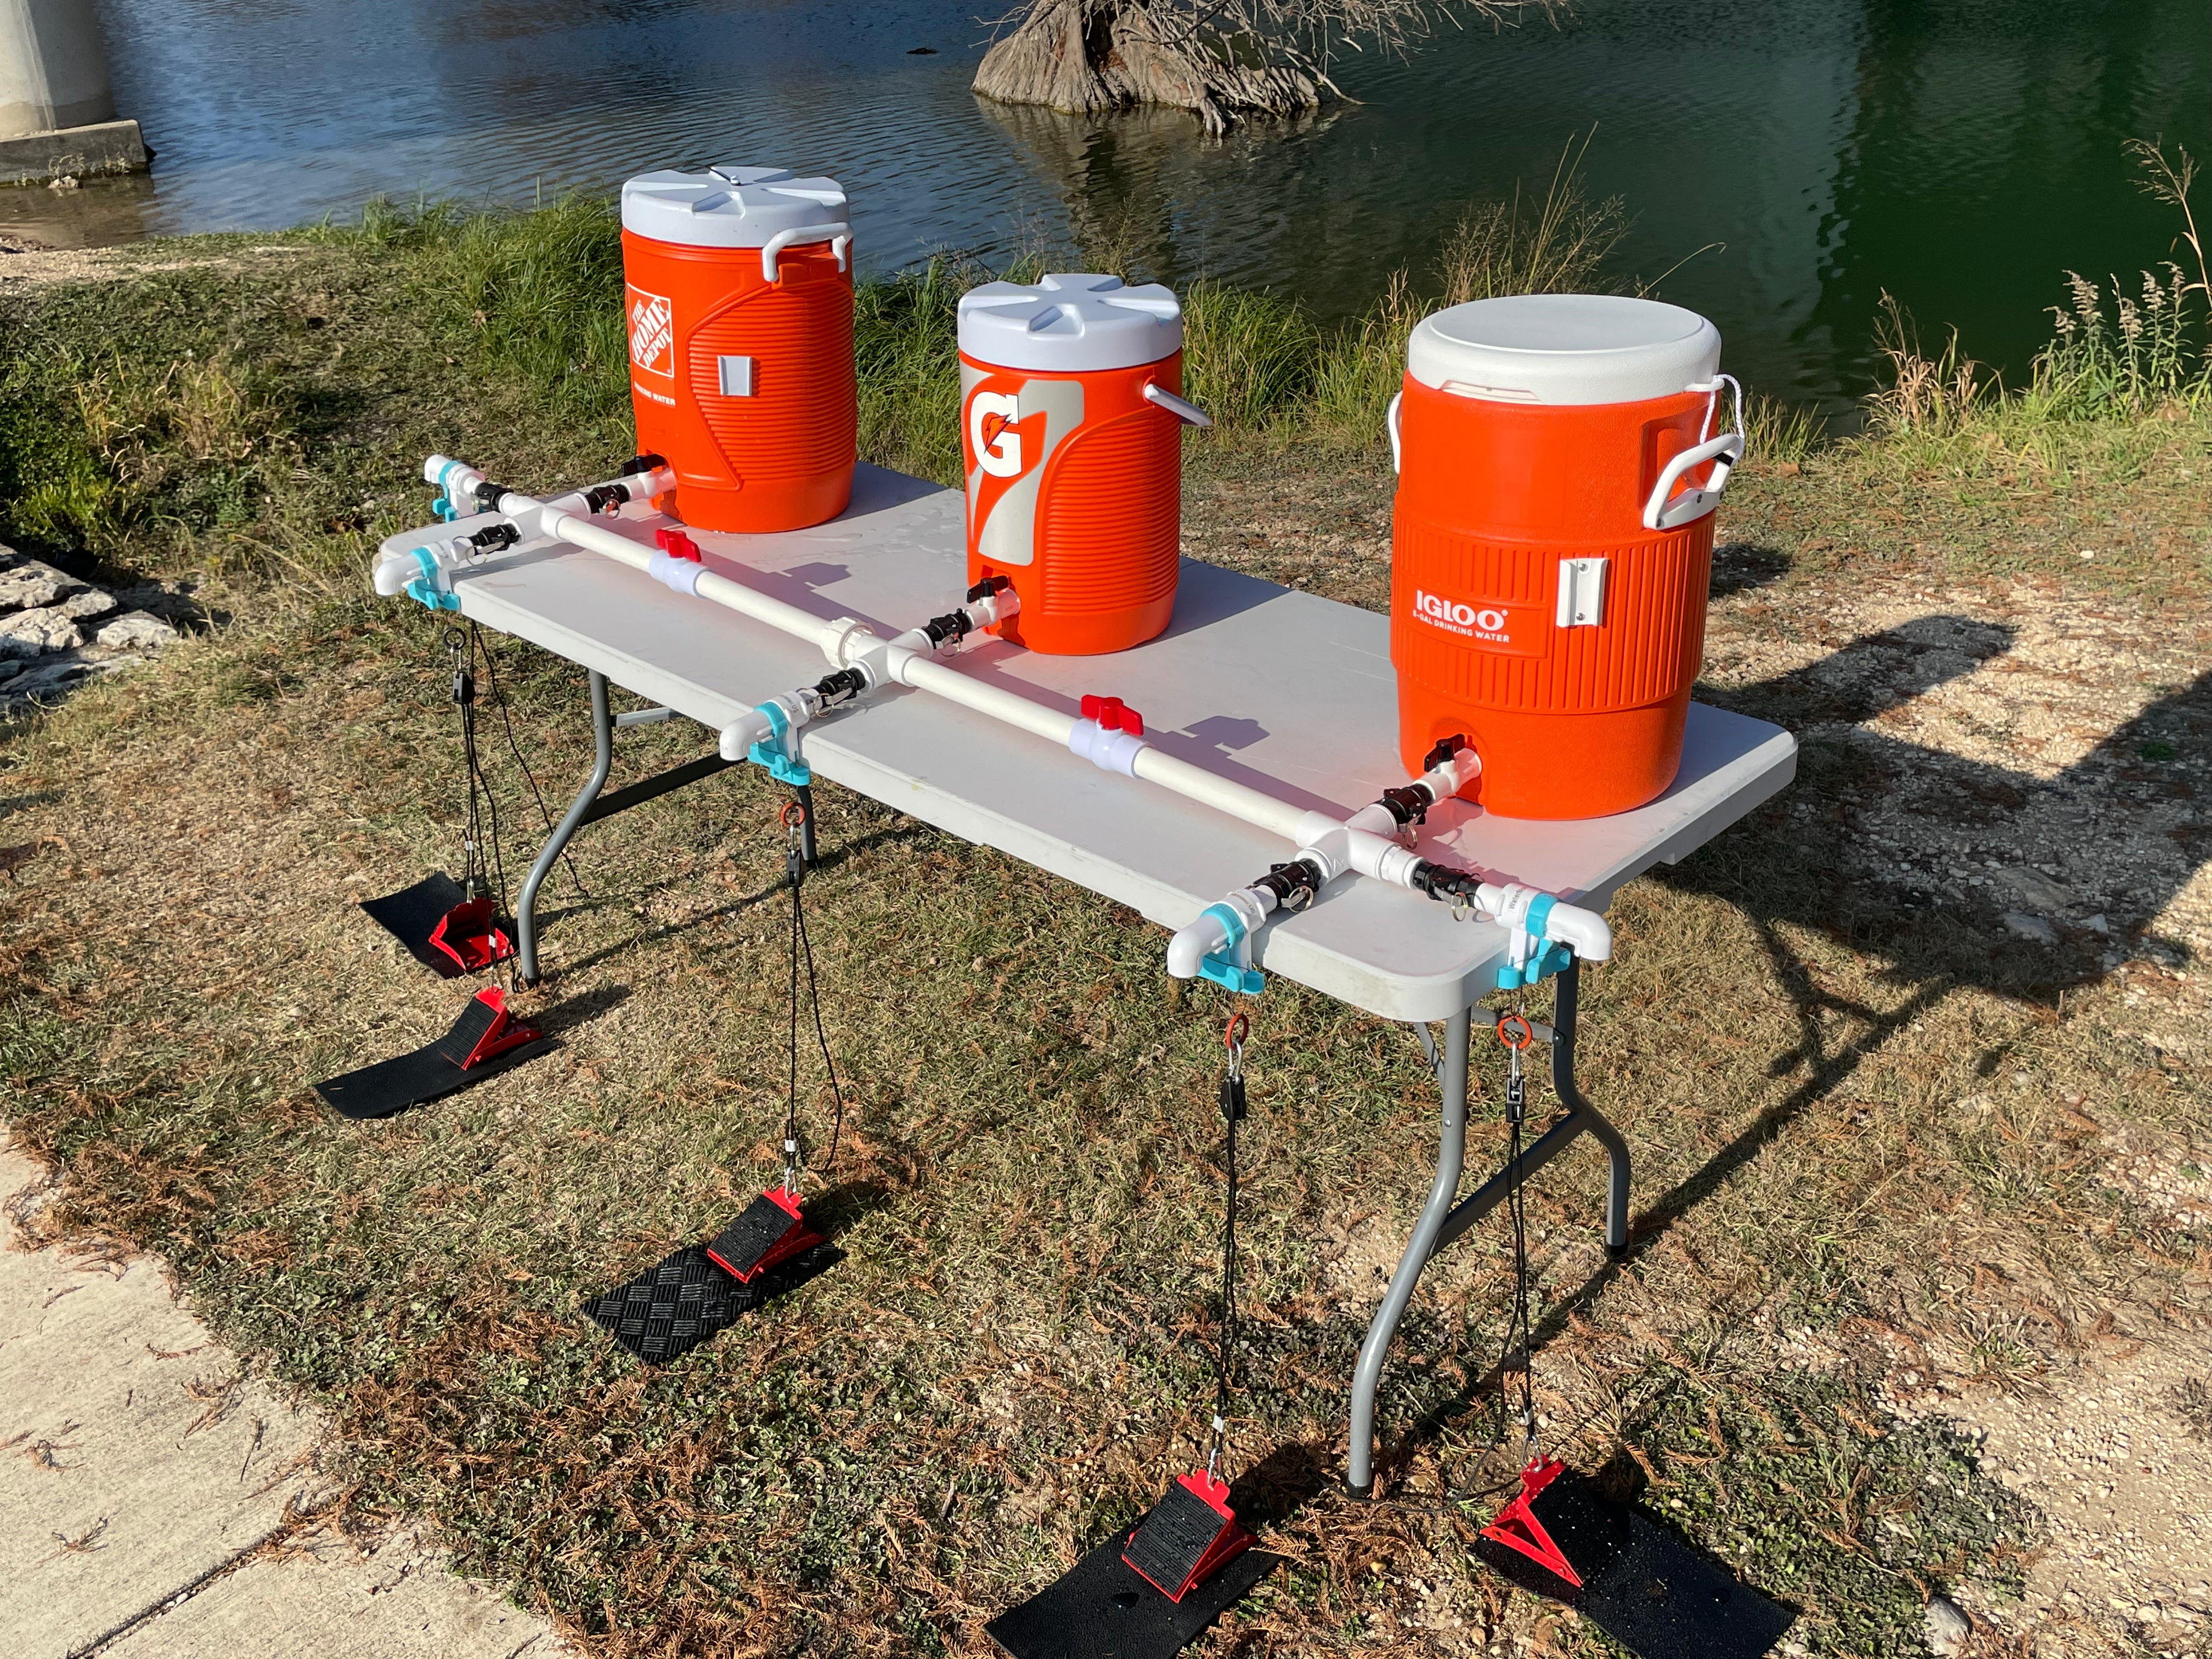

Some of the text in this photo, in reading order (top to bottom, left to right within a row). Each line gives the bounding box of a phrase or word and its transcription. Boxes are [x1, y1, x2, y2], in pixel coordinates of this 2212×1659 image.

[633, 299, 645, 325] THE
[632, 296, 670, 363] HOME
[642, 327, 672, 369] DEPOT
[652, 393, 676, 405] WATER
[1434, 619, 1473, 637] DRINKING
[1475, 630, 1510, 643] WATER
